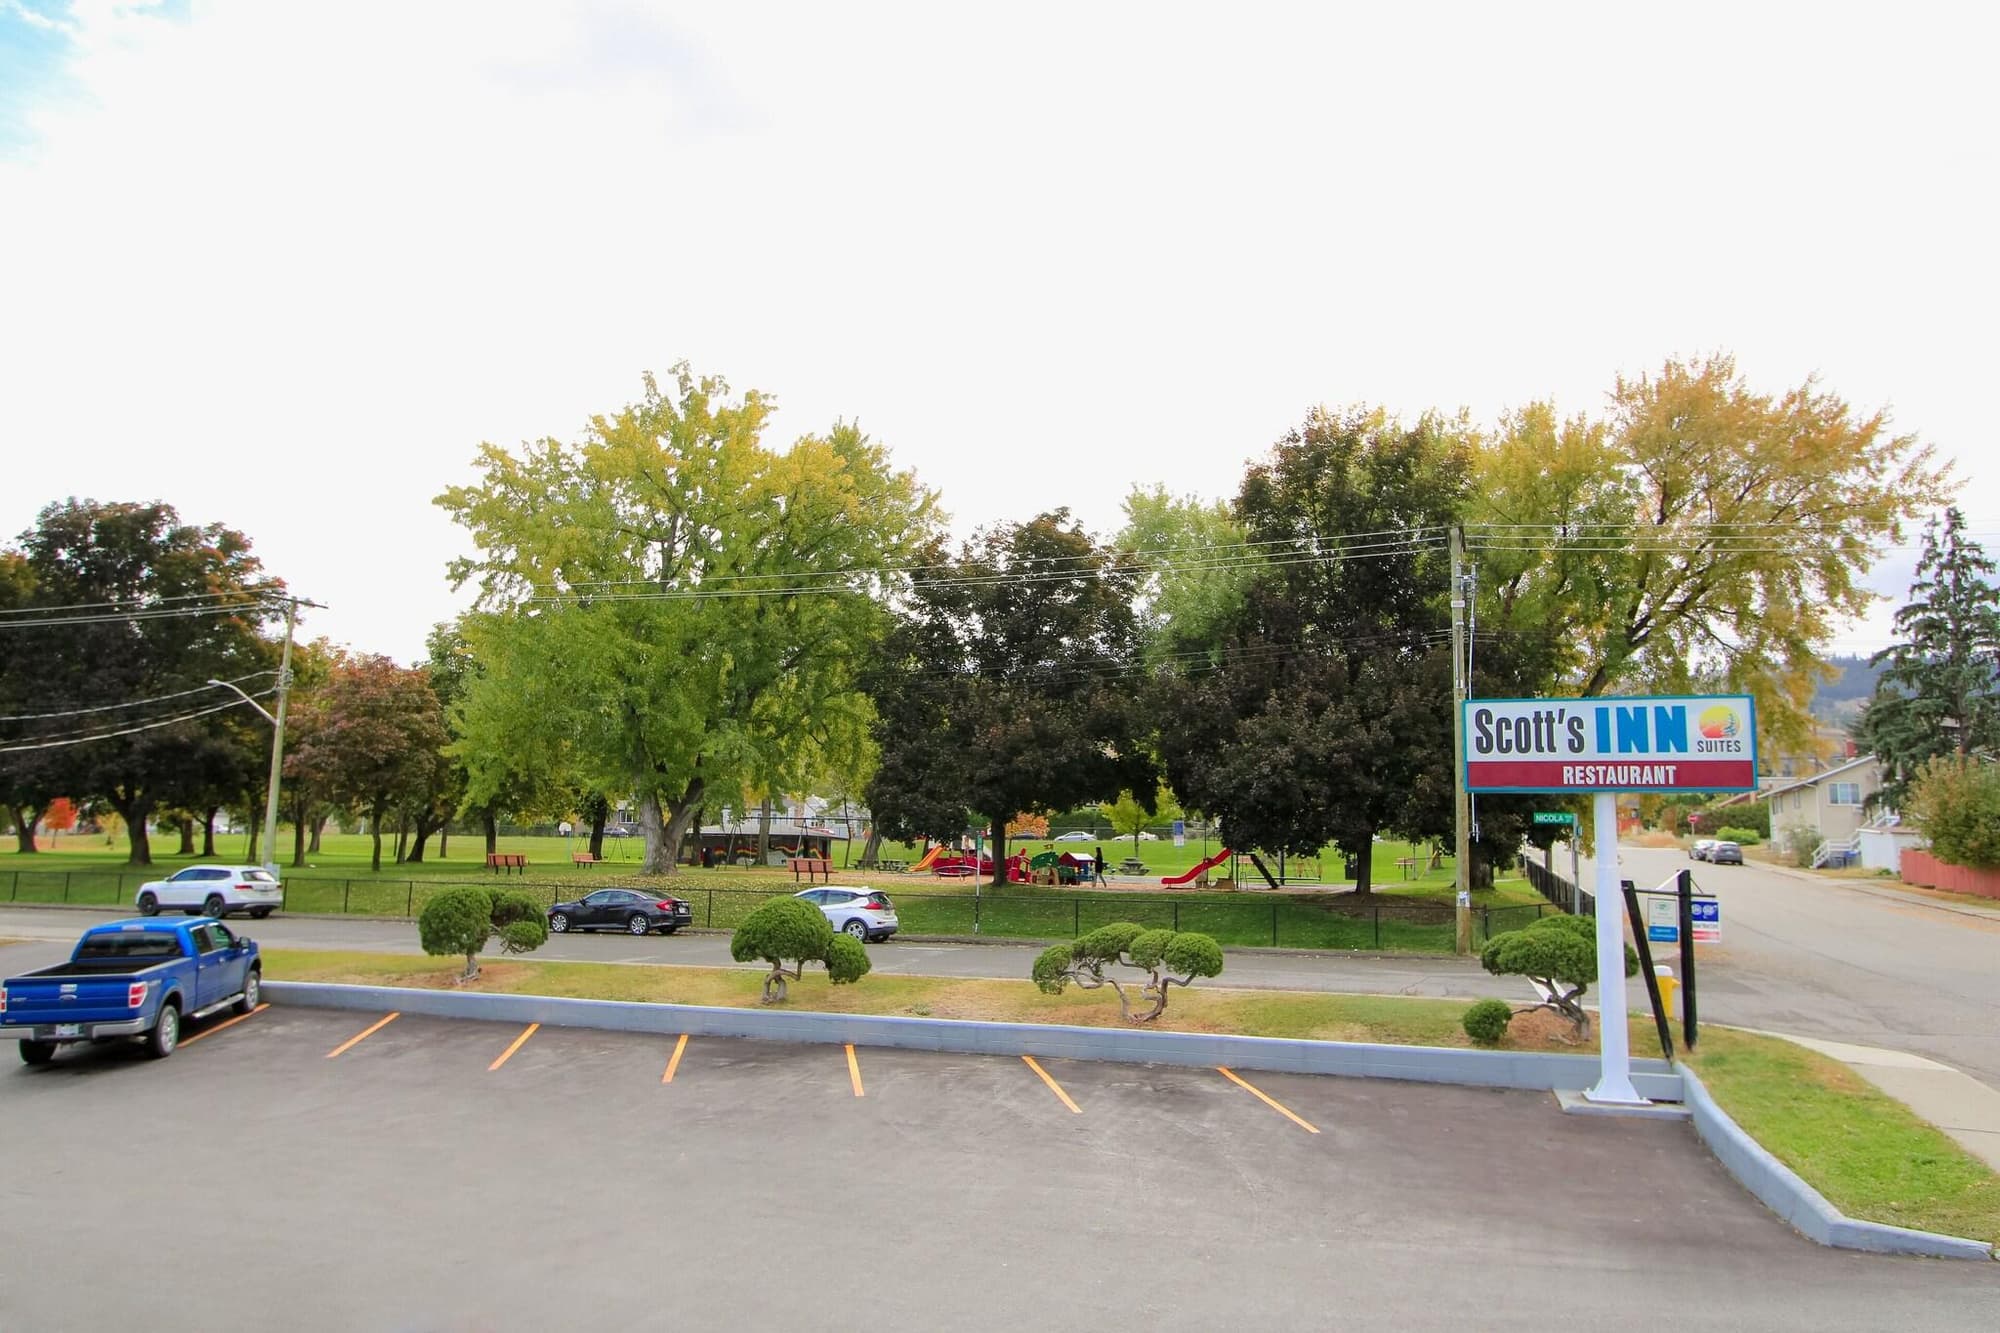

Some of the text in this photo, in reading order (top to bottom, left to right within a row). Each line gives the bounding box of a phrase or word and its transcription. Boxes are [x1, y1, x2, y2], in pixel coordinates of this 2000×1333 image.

[1475, 706, 1688, 754] Scott's INN
[1697, 740, 1742, 753] SUITES
[1563, 765, 1677, 785] RESTAURANT
[1535, 814, 1564, 823] NICOLA
